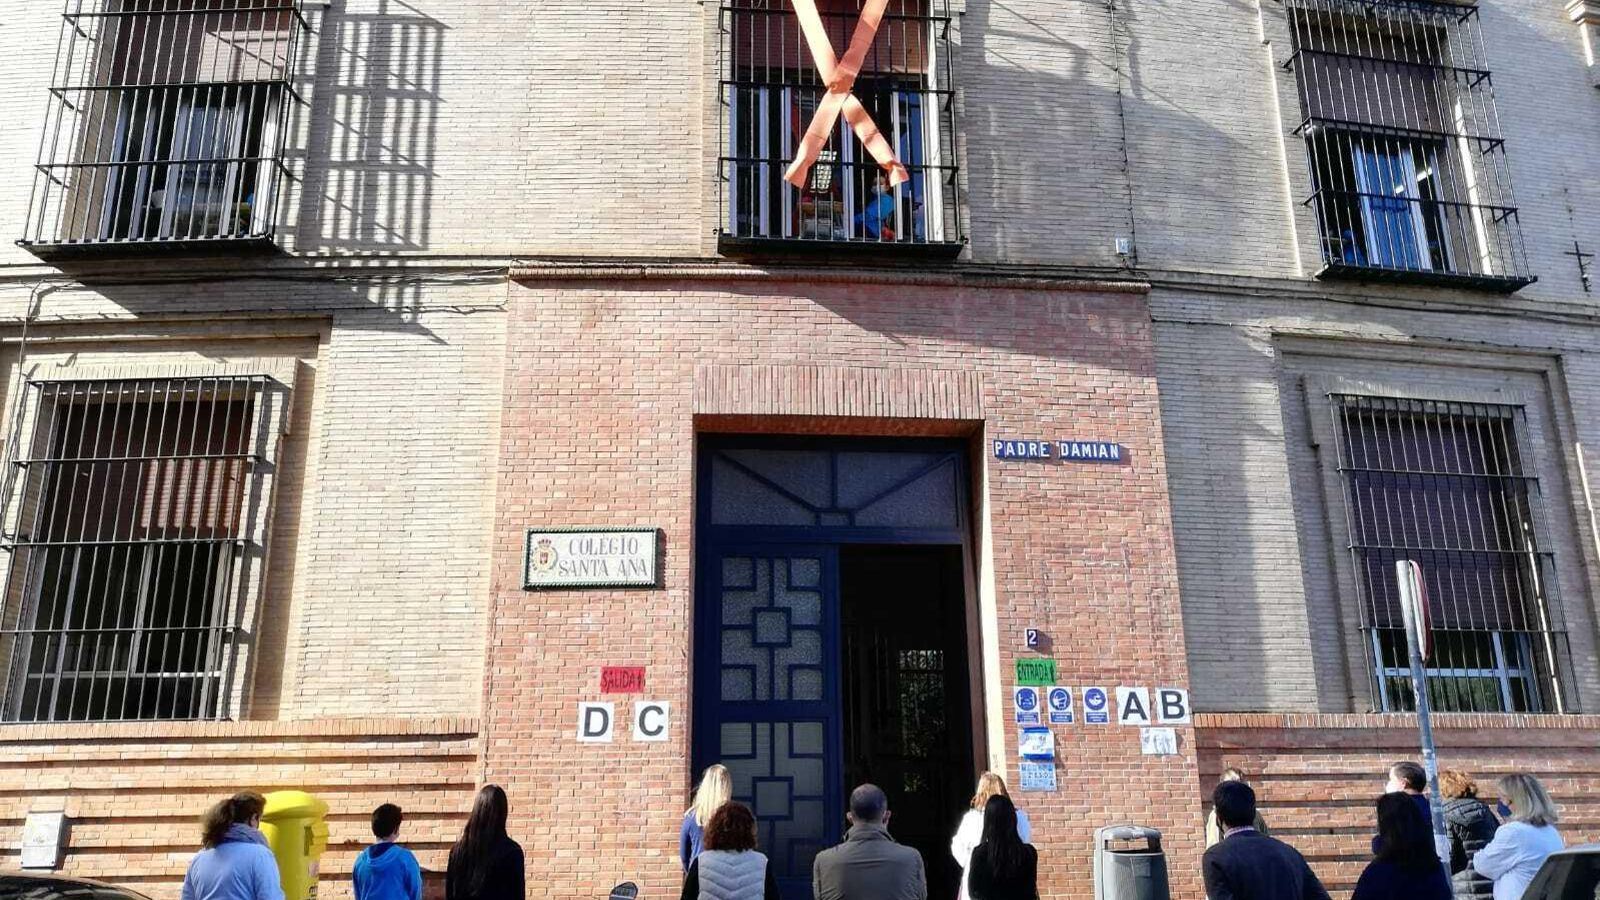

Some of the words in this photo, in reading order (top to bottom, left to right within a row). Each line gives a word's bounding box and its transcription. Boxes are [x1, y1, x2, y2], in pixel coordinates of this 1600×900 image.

[994, 441, 1050, 457] PADRE
[1060, 442, 1119, 458] DAMIAN
[569, 535, 639, 555] COLEGIO
[558, 559, 609, 577] SANTA
[618, 559, 648, 577] ANA
[1028, 631, 1038, 645] 2
[602, 670, 634, 688] SALIDA
[1017, 663, 1048, 681] ENTRADA
[1121, 691, 1148, 720] A
[1160, 690, 1186, 720] B
[583, 706, 610, 738] D
[638, 705, 665, 737] C
